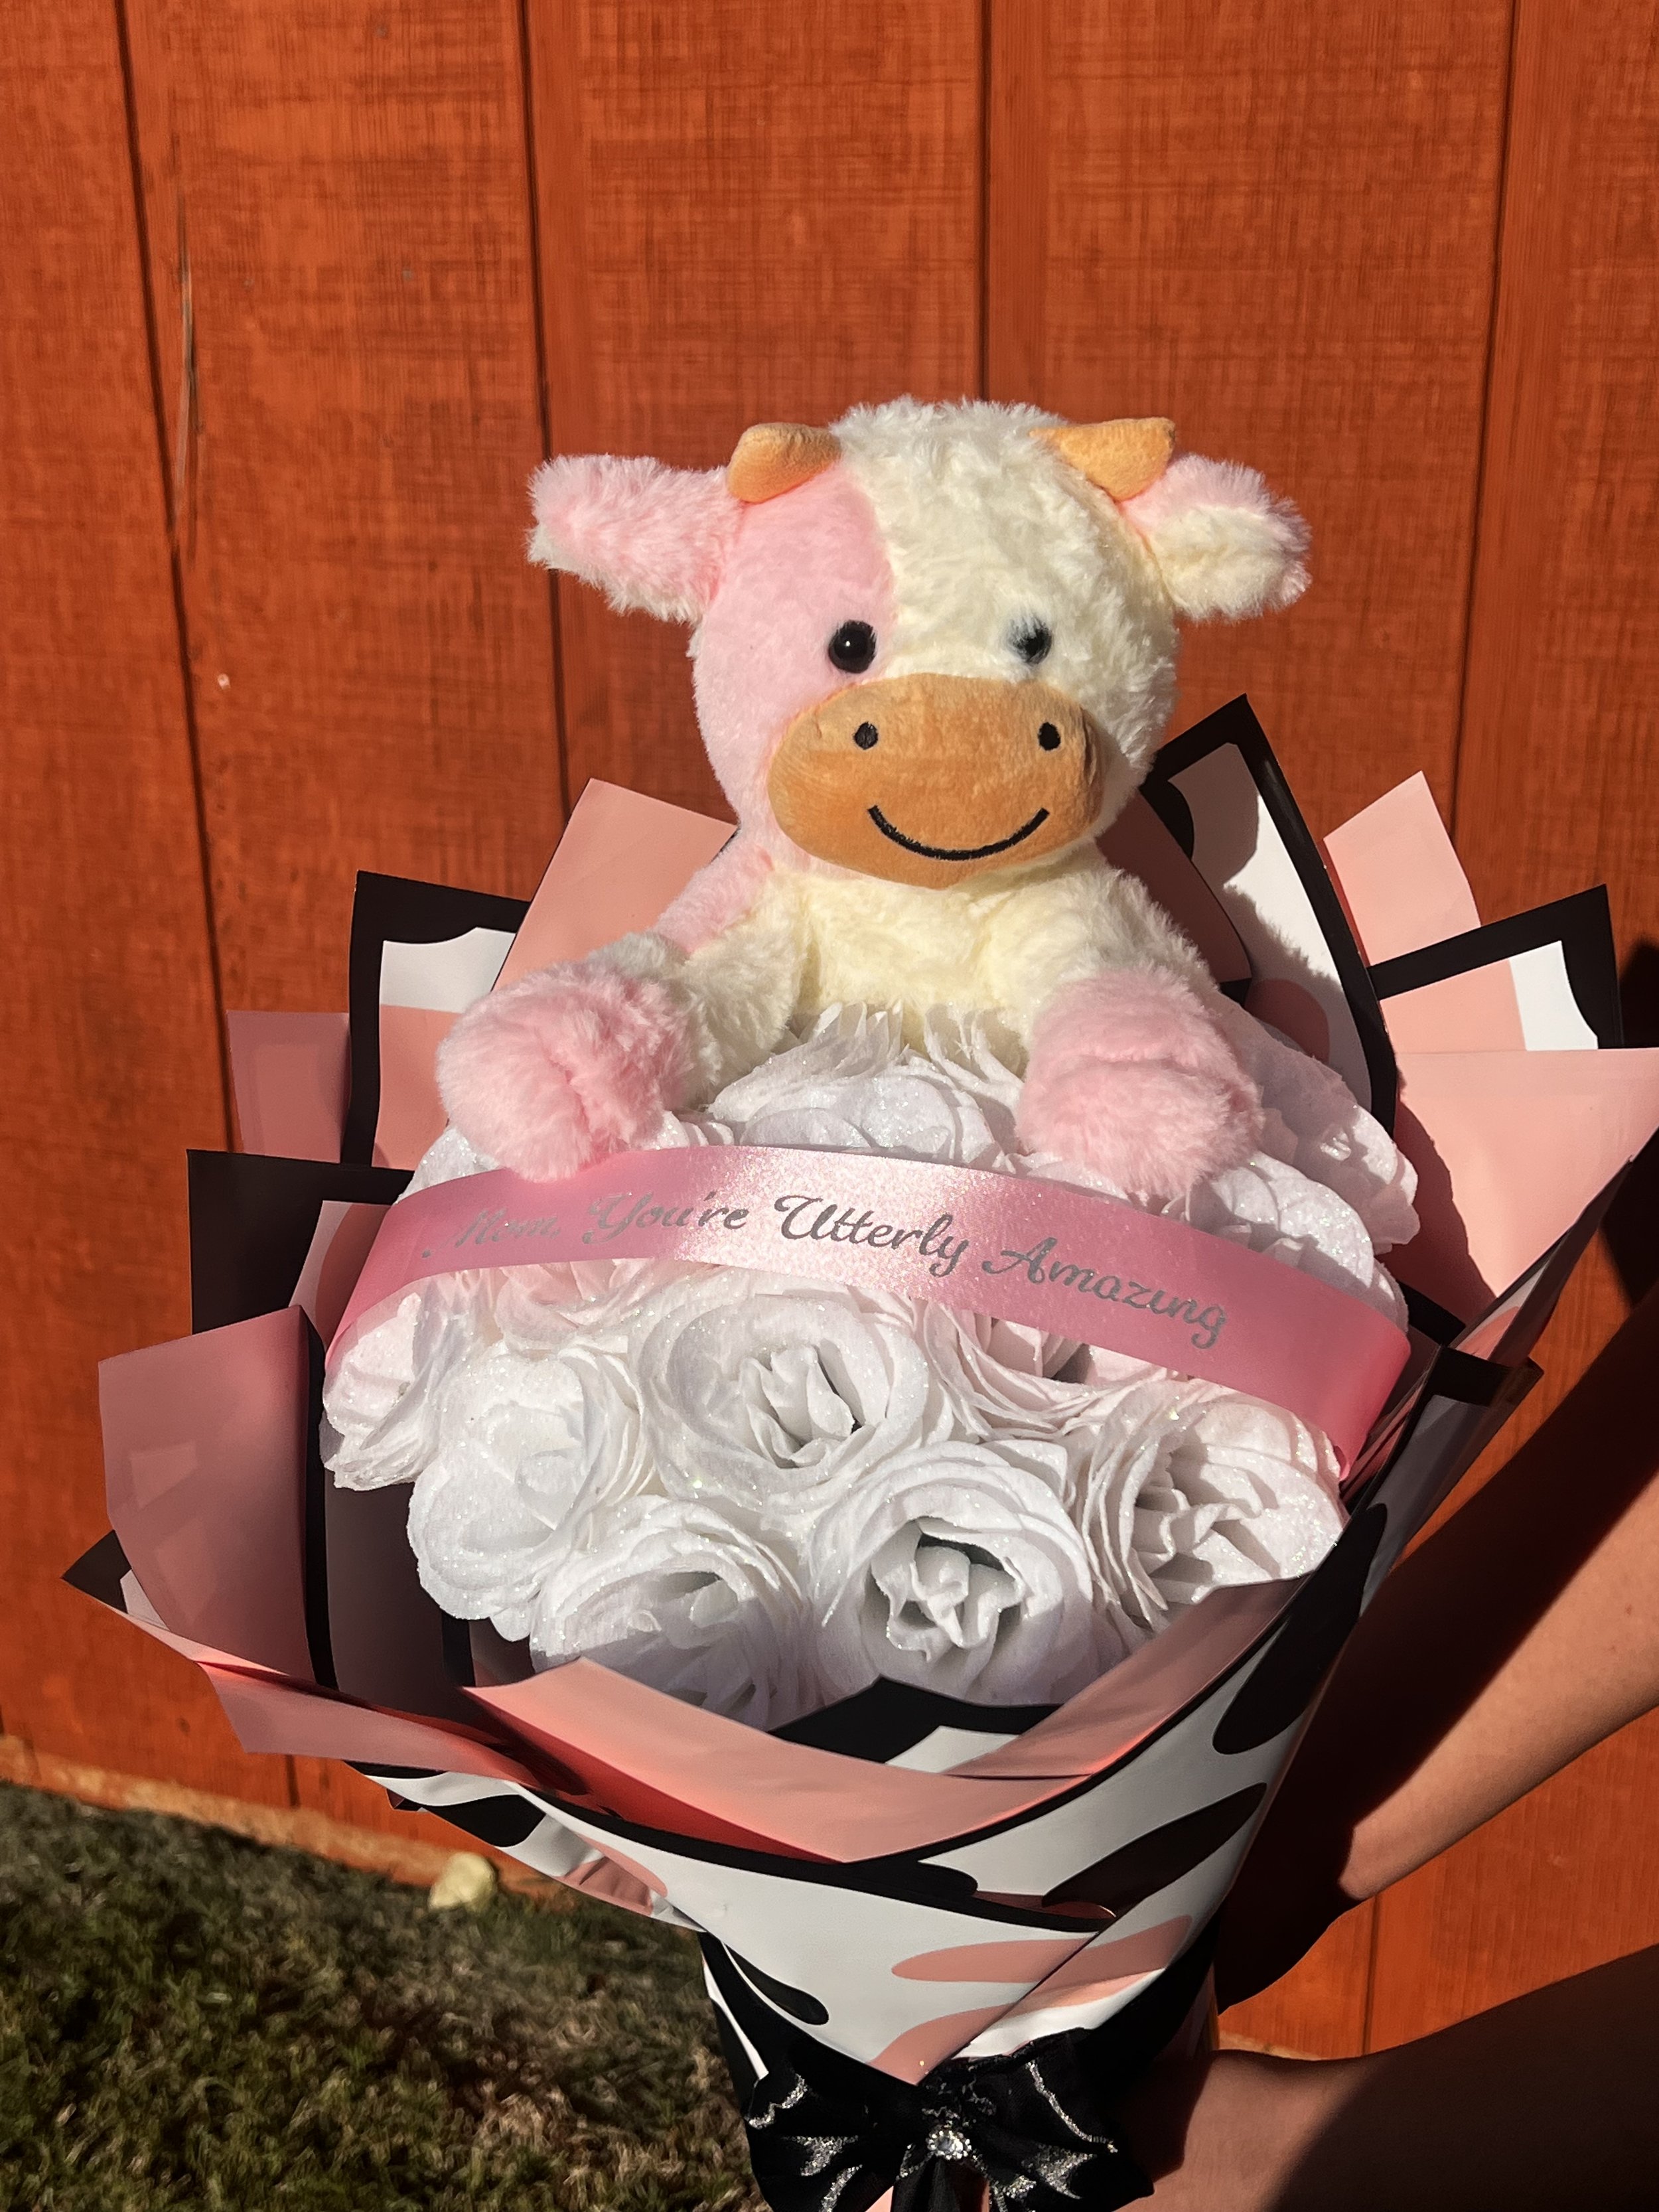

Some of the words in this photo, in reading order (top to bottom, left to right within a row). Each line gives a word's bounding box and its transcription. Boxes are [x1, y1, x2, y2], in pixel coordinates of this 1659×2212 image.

[422, 1207, 561, 1258] Mom,
[582, 1191, 749, 1244] You're
[774, 1194, 971, 1278] Utterly
[981, 1236, 1228, 1350] Amazing
